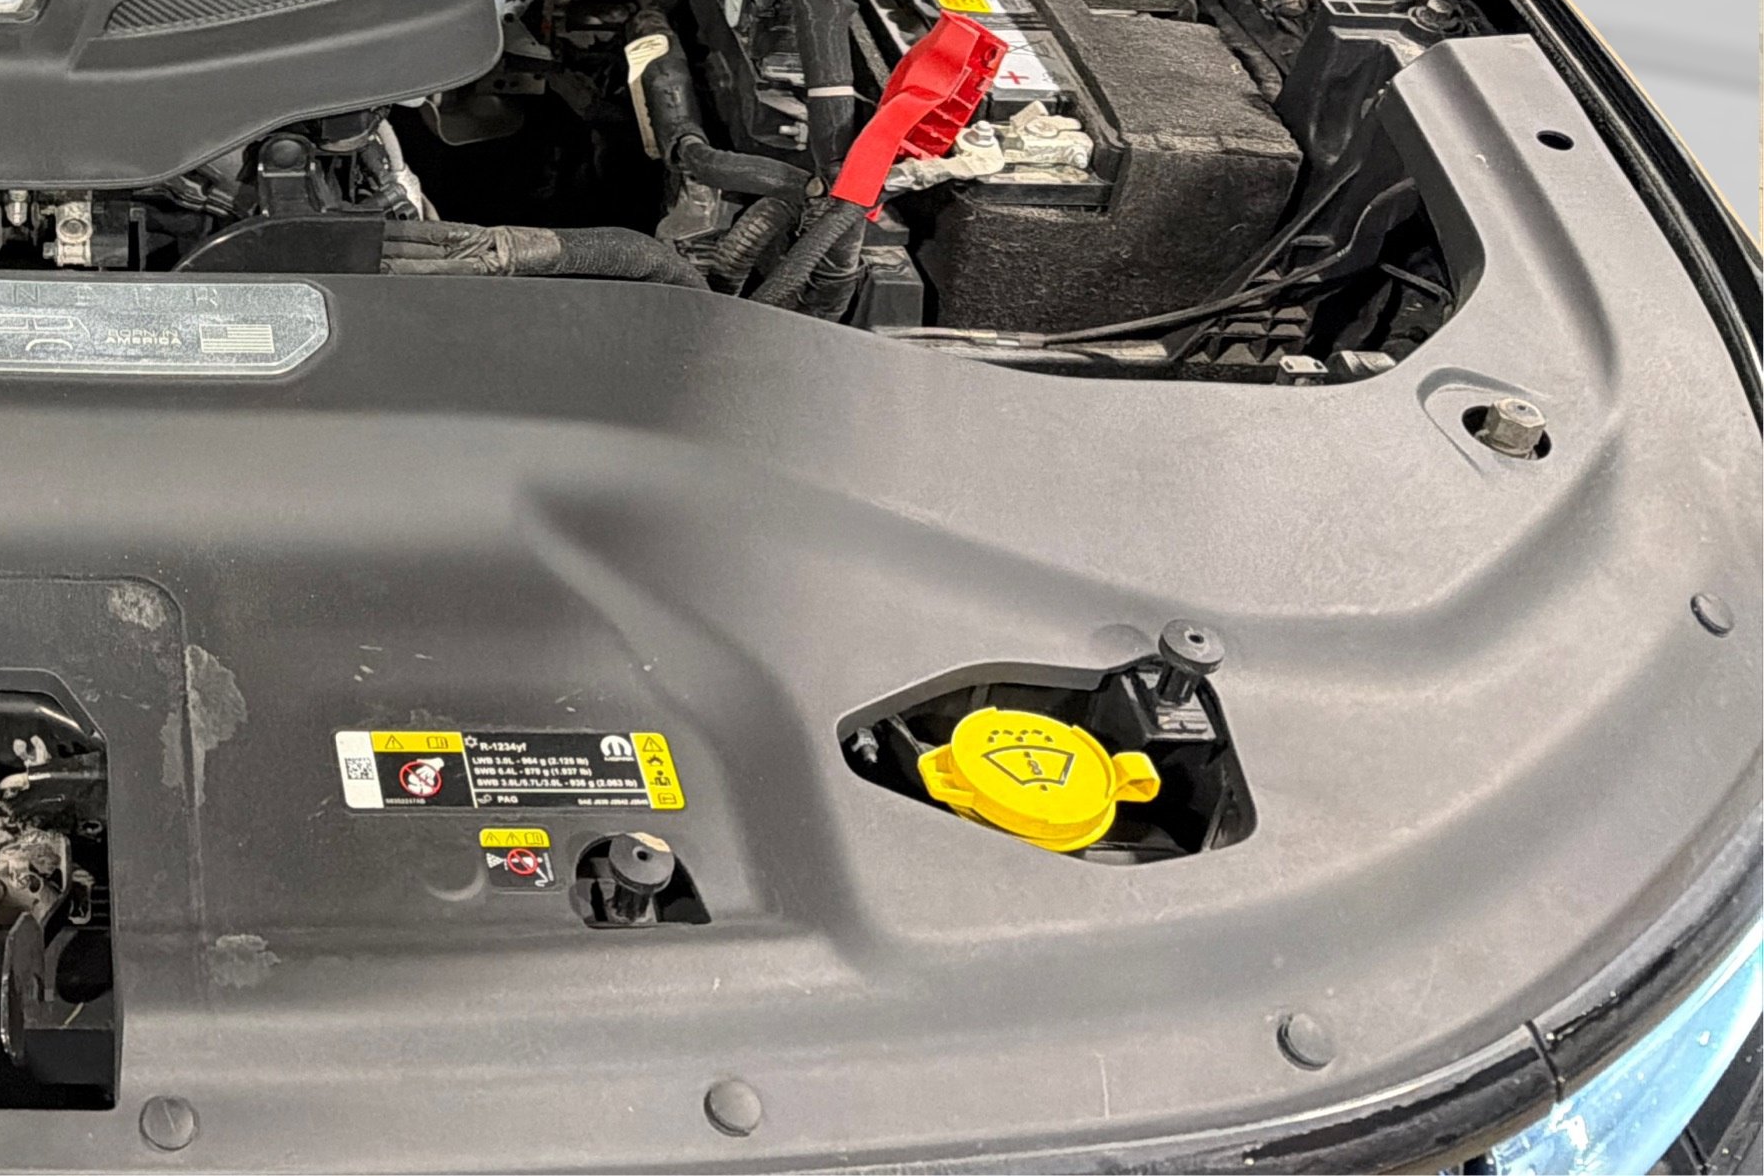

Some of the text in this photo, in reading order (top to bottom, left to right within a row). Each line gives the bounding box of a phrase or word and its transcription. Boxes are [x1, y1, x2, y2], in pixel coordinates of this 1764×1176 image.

[105, 336, 183, 346] AMERICA
[479, 742, 527, 754] R-1234yf
[496, 795, 519, 804] PAG
